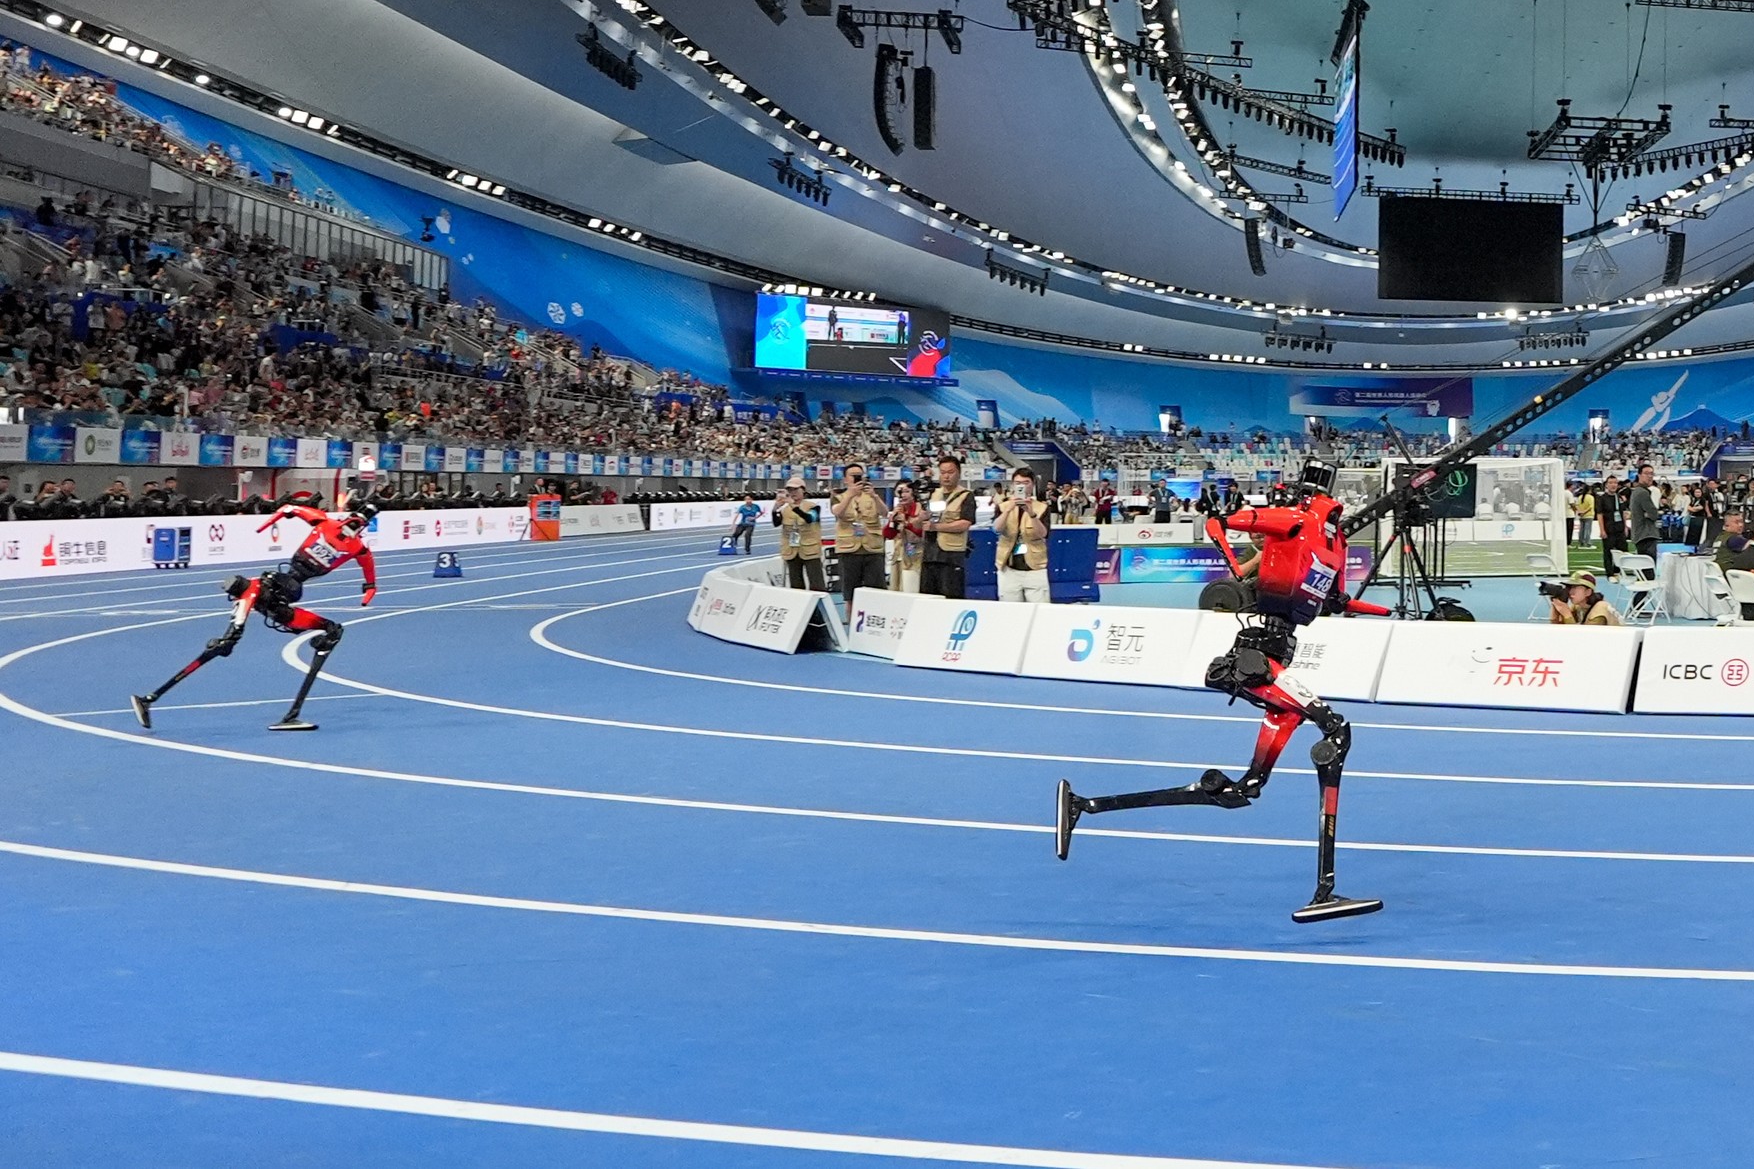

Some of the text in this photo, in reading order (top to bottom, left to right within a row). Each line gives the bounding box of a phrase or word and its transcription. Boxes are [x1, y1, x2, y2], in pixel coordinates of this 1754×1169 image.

[722, 536, 732, 548] 2
[439, 553, 451, 568] 3
[1311, 573, 1333, 592] 148
[1106, 623, 1145, 652] 智元
[1493, 657, 1564, 688] 京东
[1663, 664, 1713, 680] ICBC
